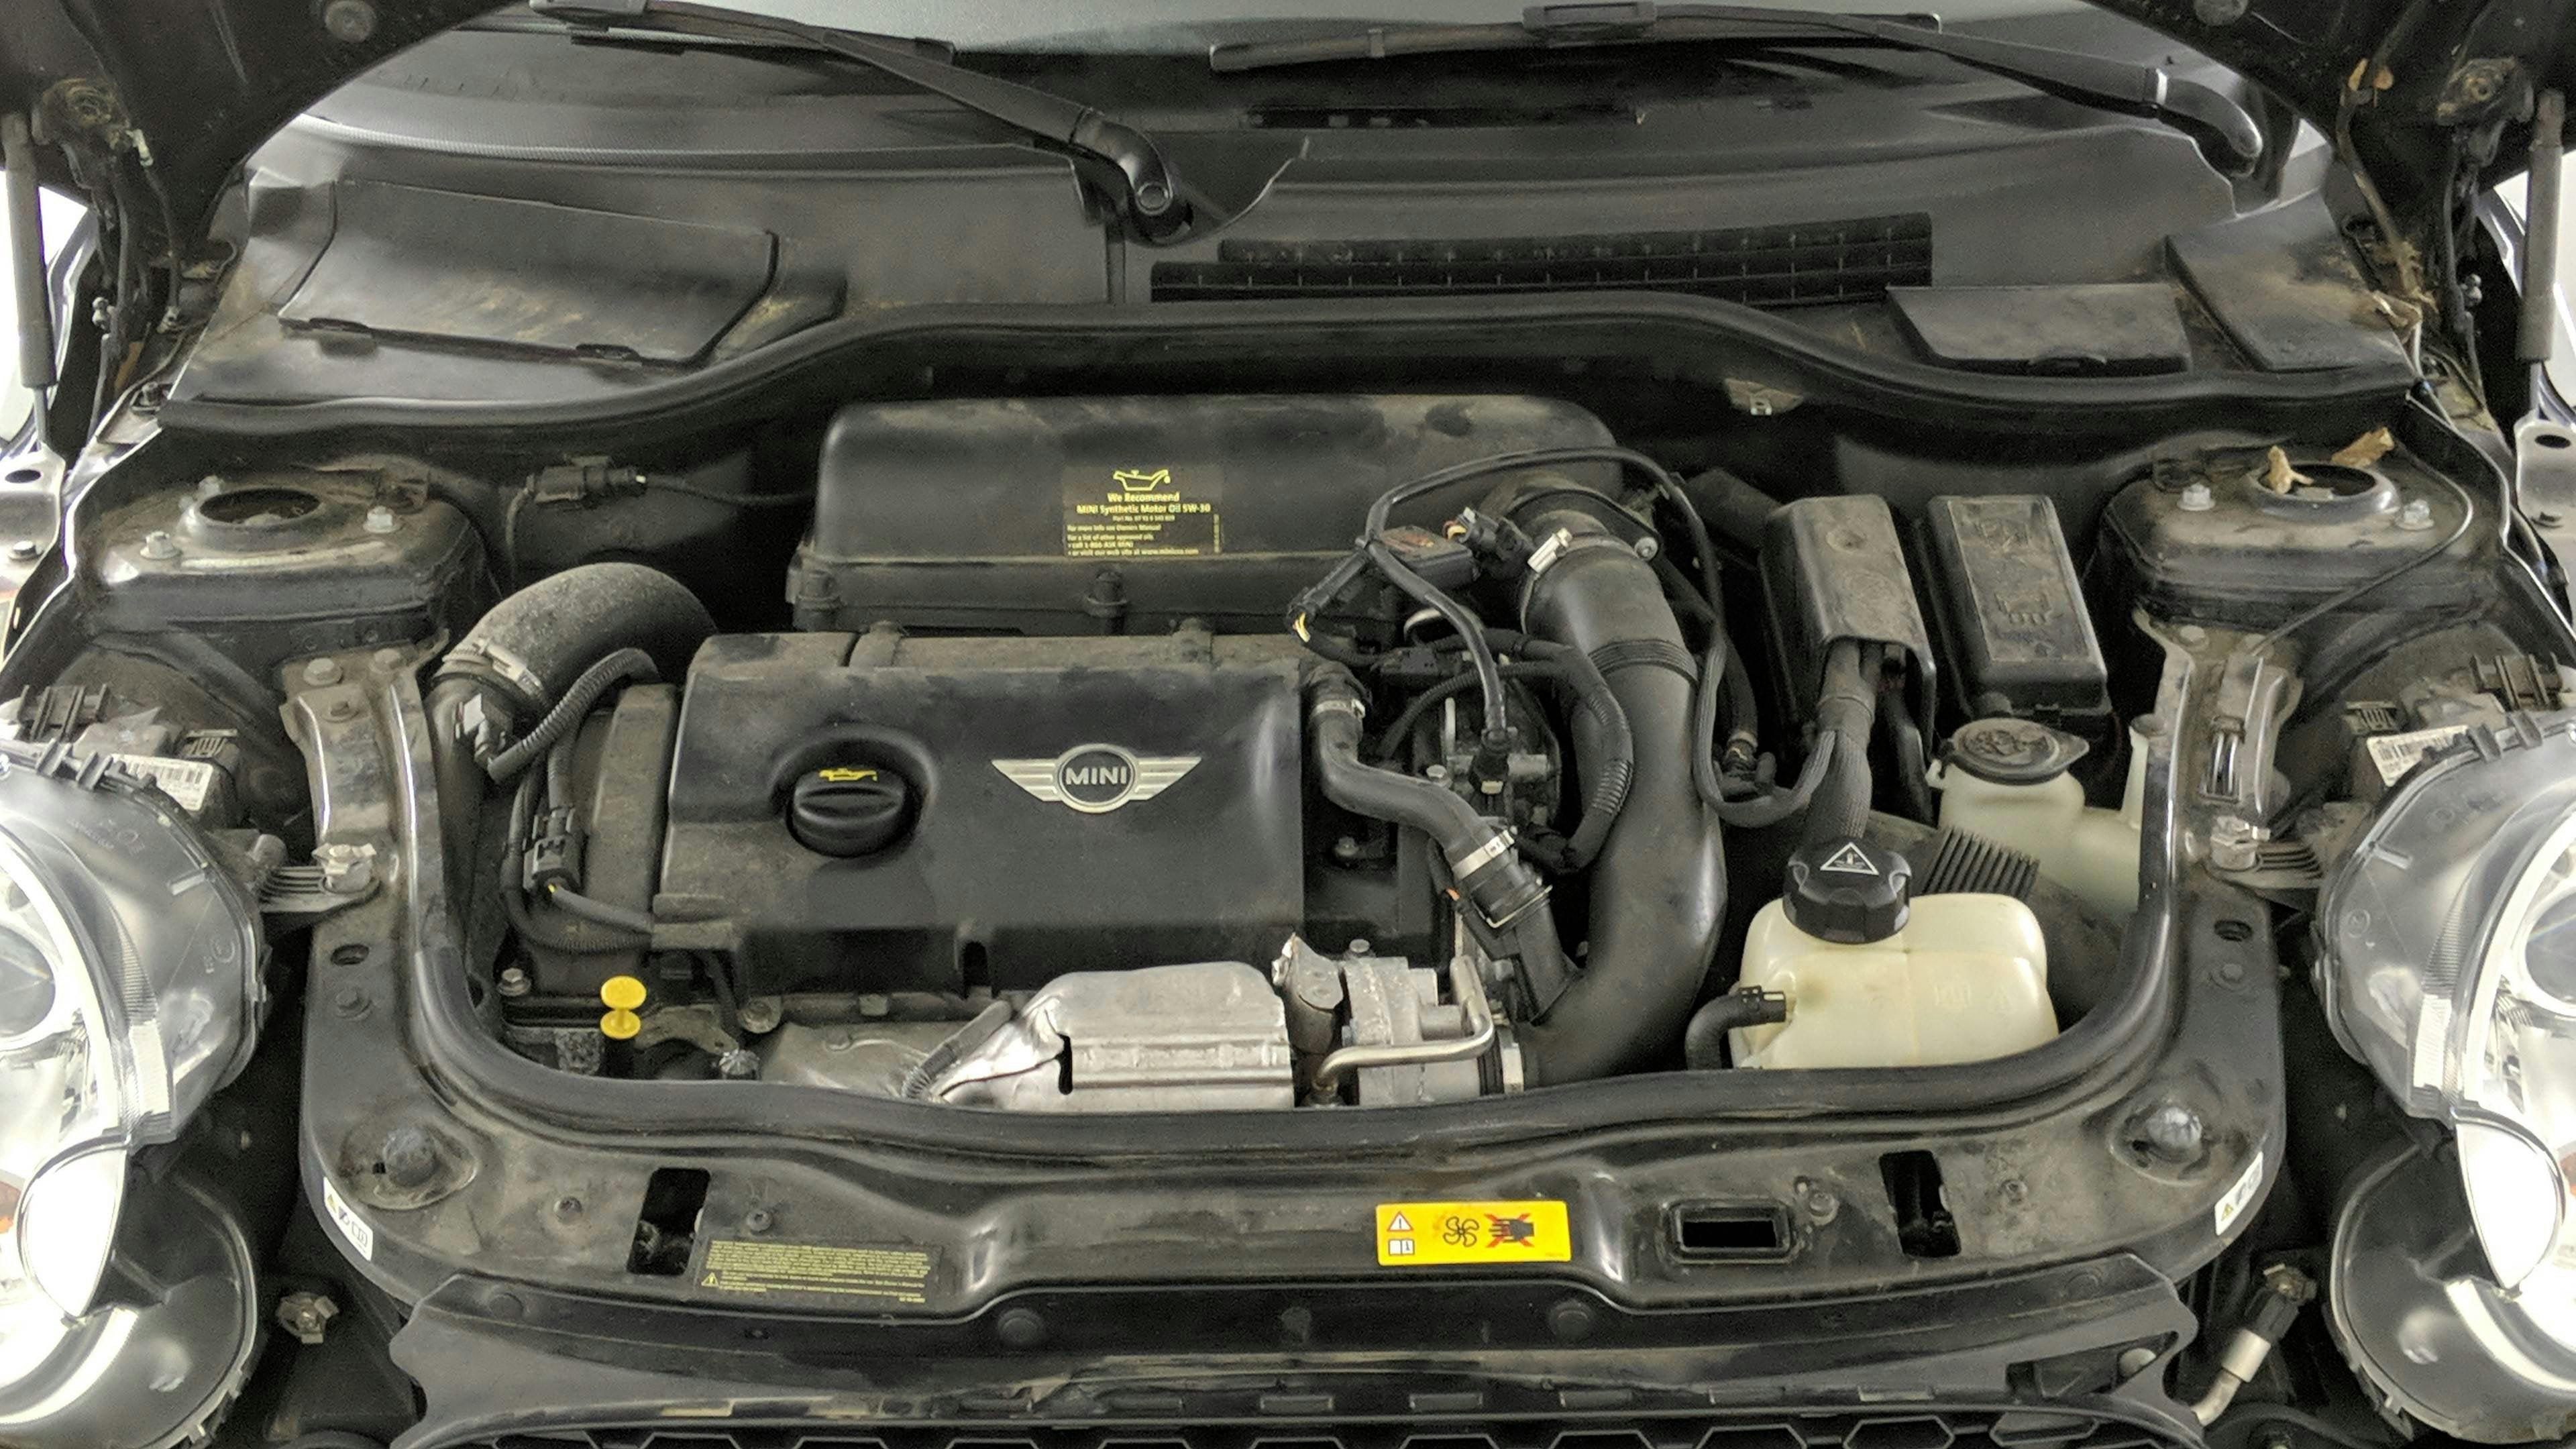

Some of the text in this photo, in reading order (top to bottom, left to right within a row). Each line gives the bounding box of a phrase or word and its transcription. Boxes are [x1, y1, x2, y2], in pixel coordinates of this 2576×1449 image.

[1107, 492, 1181, 502] We Recommend
[1076, 503, 1211, 516] MINI Synthetic Motor Oil 5W-30
[1066, 766, 1128, 785] MINI
